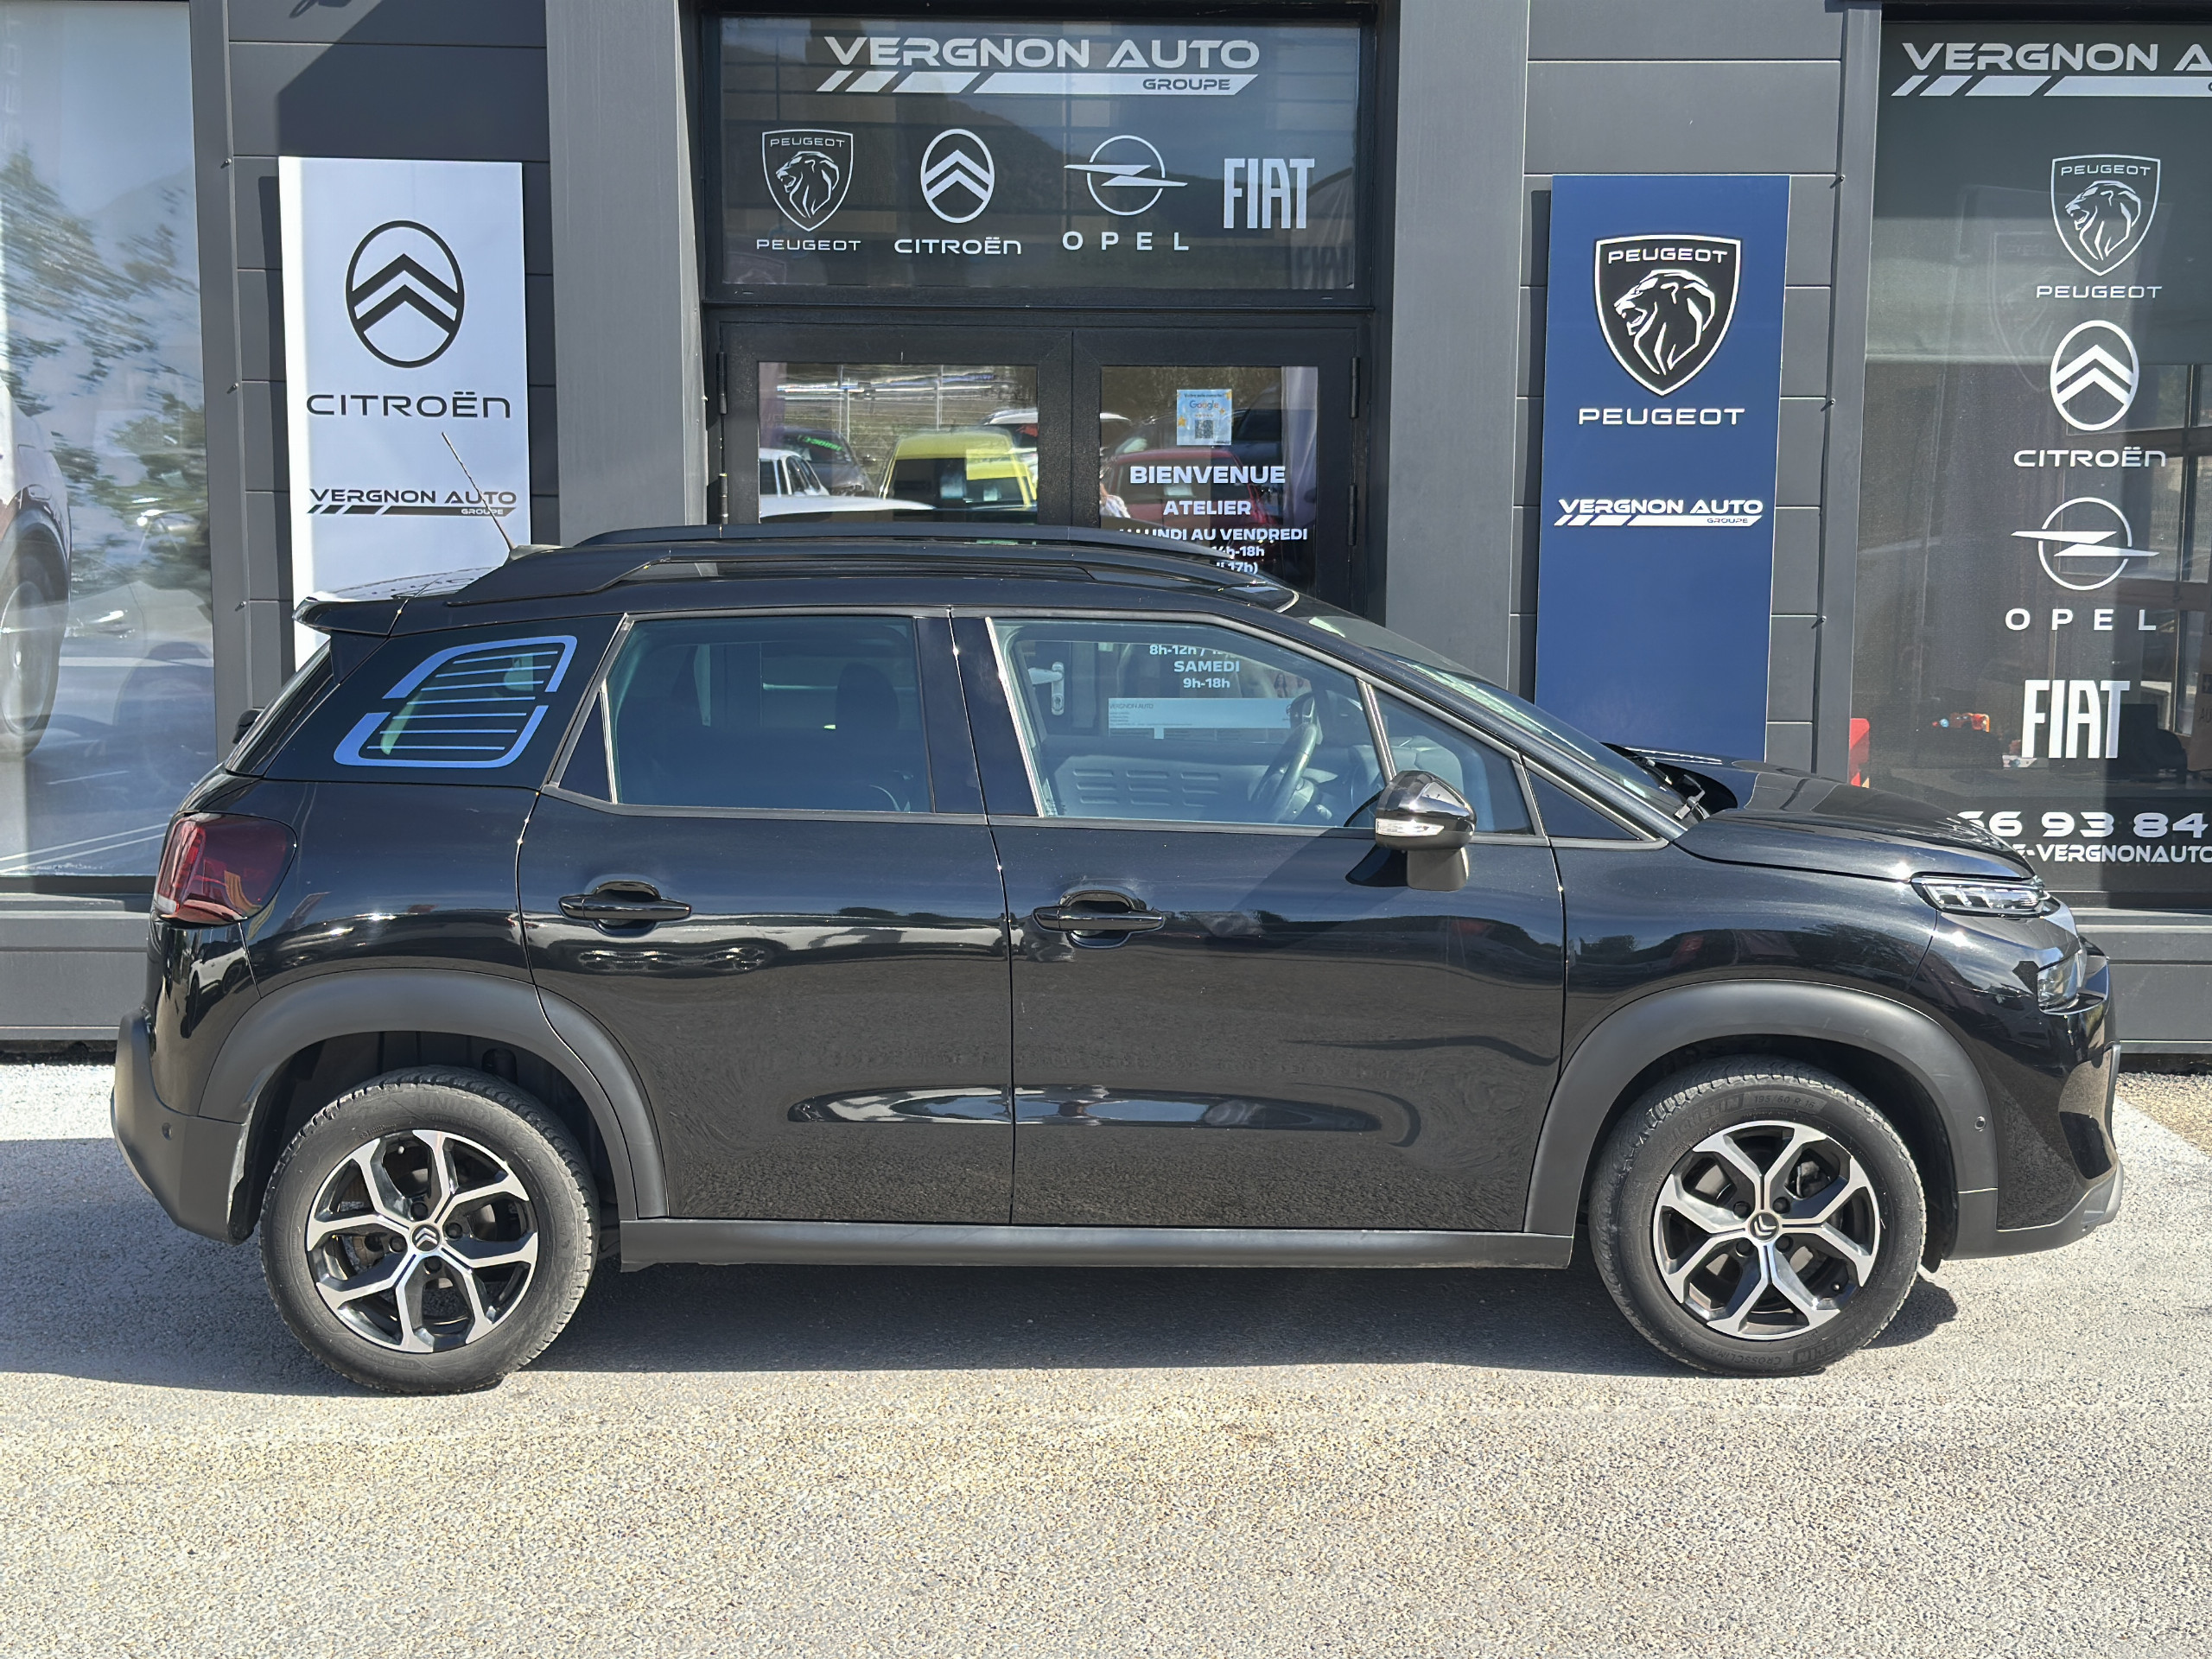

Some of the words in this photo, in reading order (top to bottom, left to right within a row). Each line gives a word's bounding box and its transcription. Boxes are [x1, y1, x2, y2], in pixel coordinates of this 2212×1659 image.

[824, 37, 1091, 67] VERGNON
[1106, 40, 1260, 68] AUTO
[1903, 43, 2158, 71] VERGNON
[1142, 79, 1230, 90] GROUPE
[770, 137, 845, 148] PEUGEOT
[2061, 164, 2152, 176] PEUGEOT
[1224, 158, 1315, 229] FIAT
[756, 239, 861, 251] PEUGEOT
[893, 236, 1021, 255] CITROËN
[1062, 232, 1190, 251] OPEL
[1608, 248, 1728, 264] PEUGEOT
[2036, 285, 2163, 299] PEUGEOT
[307, 391, 511, 419] CITROËN
[1190, 400, 1219, 410] Google
[1580, 408, 1745, 425] PEUGEOT
[2013, 447, 2166, 467] CITROËN
[1130, 466, 1286, 484] BIENVENUE
[310, 489, 435, 504] VERGNON
[444, 491, 517, 505] AUTO
[1163, 500, 1251, 515] ATELIER
[1559, 499, 1683, 514] VERGNON
[1689, 499, 1764, 514] AUTO
[1191, 529, 1216, 540] AU
[1219, 529, 1307, 540] VENDREDI
[2005, 608, 2156, 631] OPEL
[1174, 661, 1240, 672] SAMEDI
[1183, 677, 1230, 689] 9h-18h
[2022, 680, 2130, 759] FIAT
[2041, 812, 2114, 837] 93
[2133, 813, 2209, 838] 84
